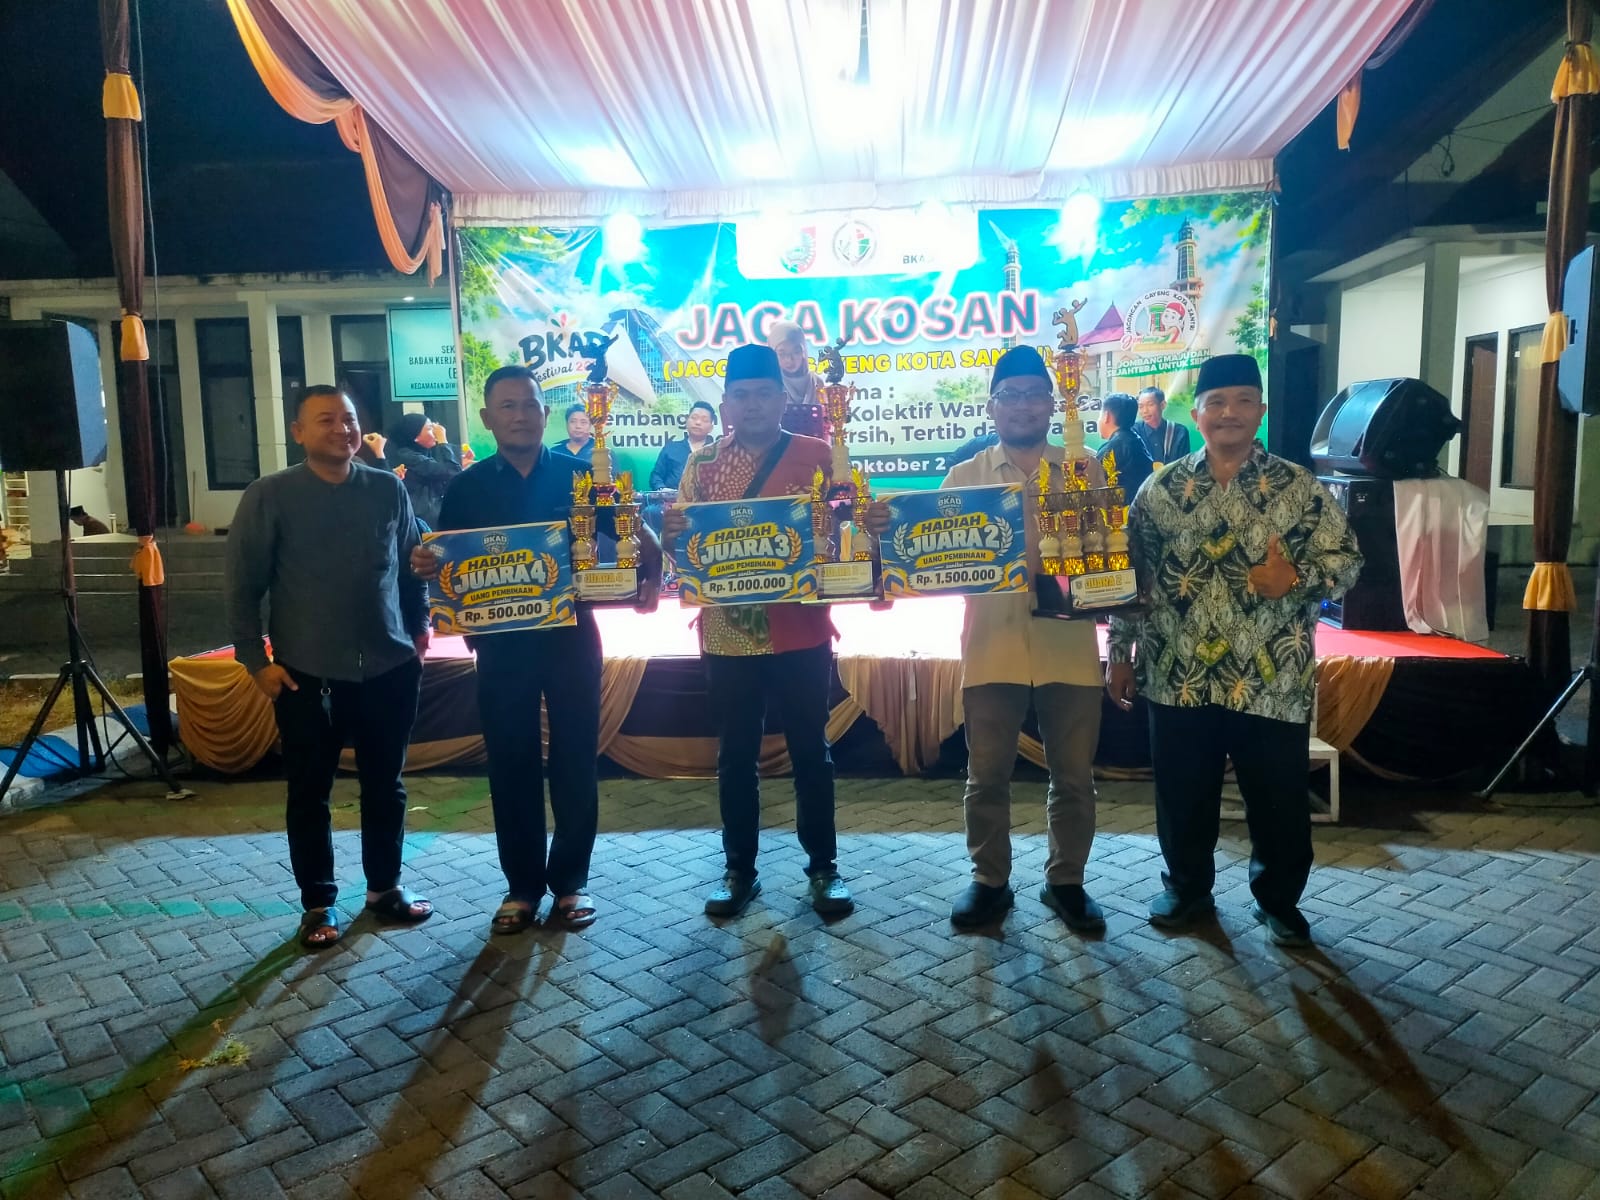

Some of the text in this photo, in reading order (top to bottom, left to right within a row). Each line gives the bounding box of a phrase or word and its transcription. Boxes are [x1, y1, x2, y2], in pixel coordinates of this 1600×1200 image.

[1173, 294, 1188, 306] KOTA
[840, 290, 1037, 344] KOSAN
[409, 356, 434, 365] BADAN
[896, 351, 955, 371] KOTA
[849, 401, 933, 422] Kolektif
[901, 423, 966, 441] Tertib
[973, 422, 999, 438] da
[714, 525, 771, 542] HADIAH
[921, 515, 981, 534] HADIAH
[701, 534, 790, 564] JUARA 3
[907, 525, 1000, 557] JUARA 2
[468, 552, 527, 572] HADIAH
[716, 560, 777, 573] UANG PEMBINAAN
[923, 552, 986, 564] UANG PEMBINAAN
[455, 559, 546, 594] JUARA 4
[709, 577, 786, 594] Rp. 1.000.000
[916, 568, 995, 586] Rp. 1.500.000
[470, 591, 490, 601] UANG
[491, 587, 533, 597] PEMBINAAN
[465, 602, 542, 623] Rp. 500.000
